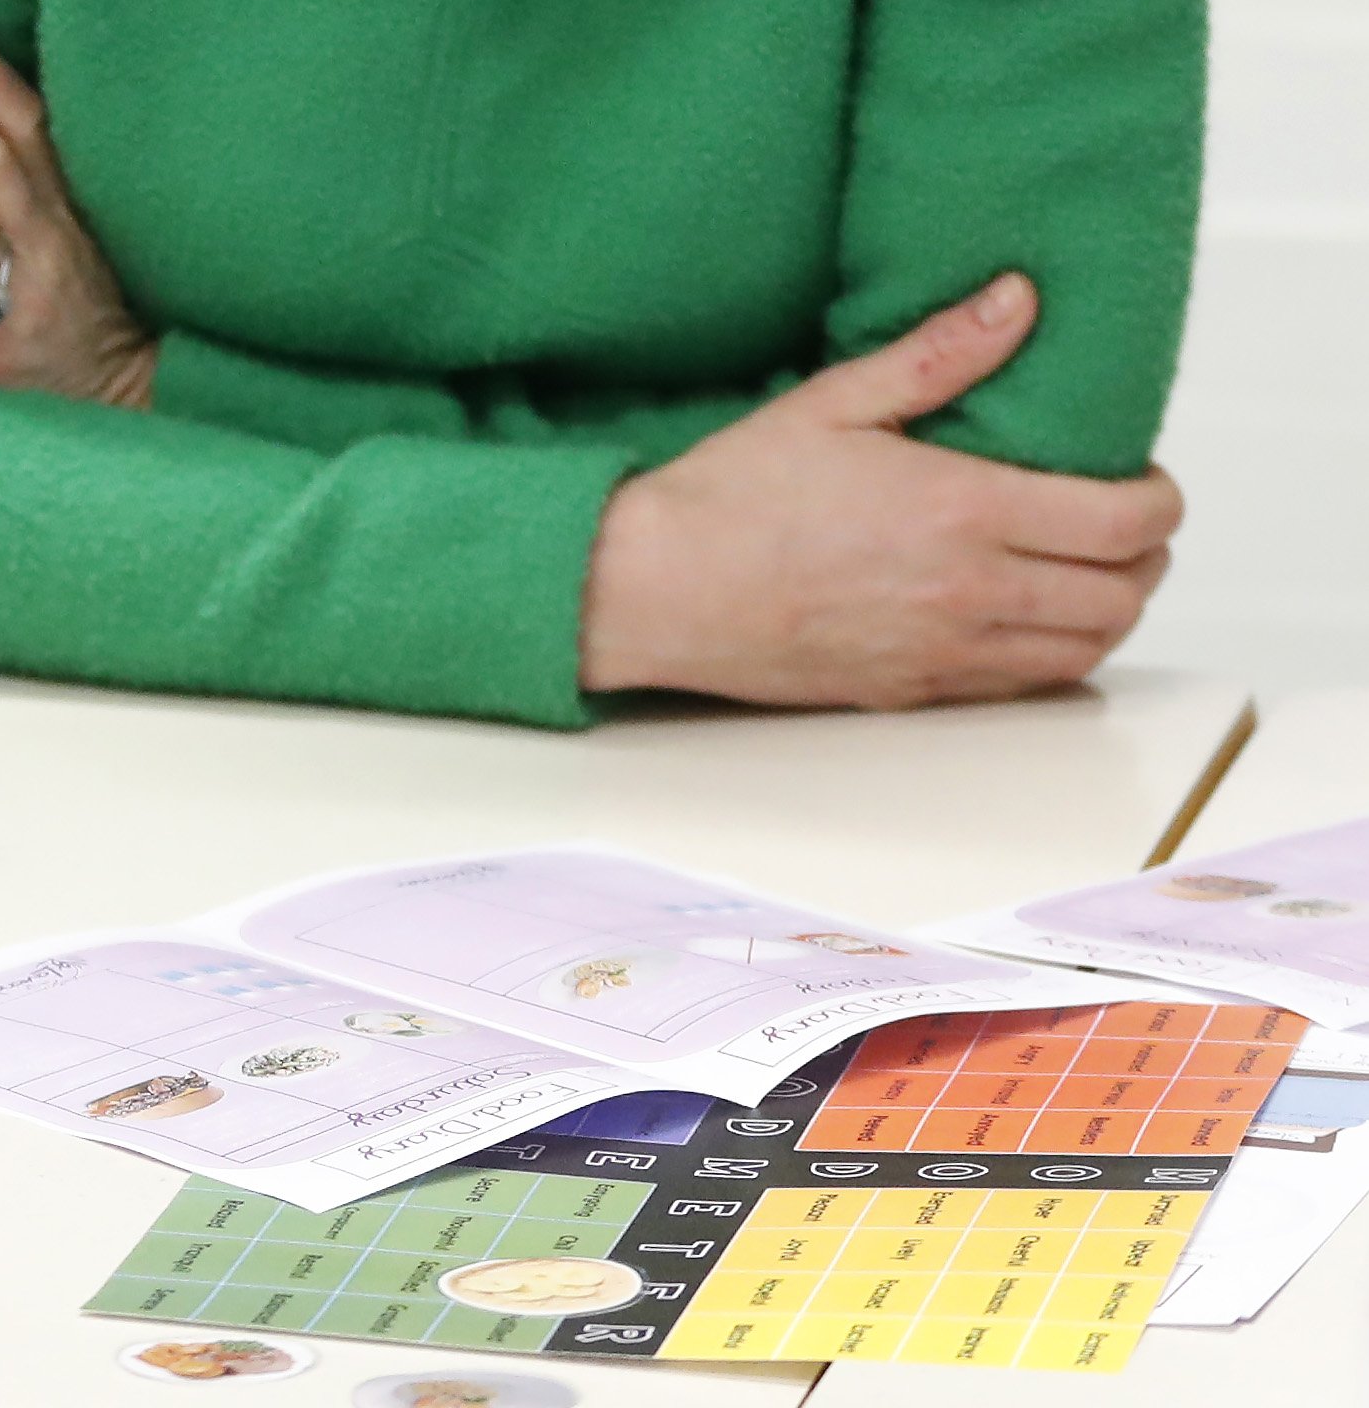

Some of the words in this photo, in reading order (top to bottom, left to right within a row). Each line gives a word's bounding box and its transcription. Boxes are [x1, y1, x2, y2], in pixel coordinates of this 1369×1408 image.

[761, 1002, 879, 1043] Diary
[1148, 1008, 1177, 1032] Furious
[1014, 1045, 1044, 1065] Angry
[348, 1068, 531, 1127] Saturday
[473, 1082, 579, 1119] Food
[1101, 1082, 1134, 1106] Nervous
[358, 1120, 480, 1160] Diary
[857, 1115, 890, 1142] Peeved
[965, 1113, 1000, 1147] Annoyed
[1079, 1117, 1112, 1145] Restless
[1190, 1118, 1223, 1147] Stunned
[811, 1162, 1218, 1184] MOOD
[464, 1177, 501, 1203] Secure
[573, 1183, 616, 1218] Easygoing
[205, 1199, 245, 1229] Relaxed
[803, 1194, 840, 1222] Pleasant
[914, 1191, 954, 1225] Energized
[1033, 1198, 1064, 1219] Hyper
[1144, 1194, 1180, 1226] Surprised
[432, 1216, 473, 1251] Thoughtful
[552, 1234, 581, 1251] Chill
[171, 1242, 213, 1273] Tranquil
[778, 1238, 809, 1261] Joyful
[889, 1238, 924, 1261] Lively
[1007, 1235, 1042, 1267] Cheerful
[1125, 1239, 1156, 1267] Upbeat
[290, 1253, 325, 1281] Restful
[400, 1260, 441, 1293] Satisfied
[140, 1288, 176, 1311] Serene
[750, 1279, 784, 1306] Hopeful
[864, 1279, 901, 1309] Focused
[1098, 1281, 1133, 1320] Motivated
[838, 1324, 874, 1354] Excited
